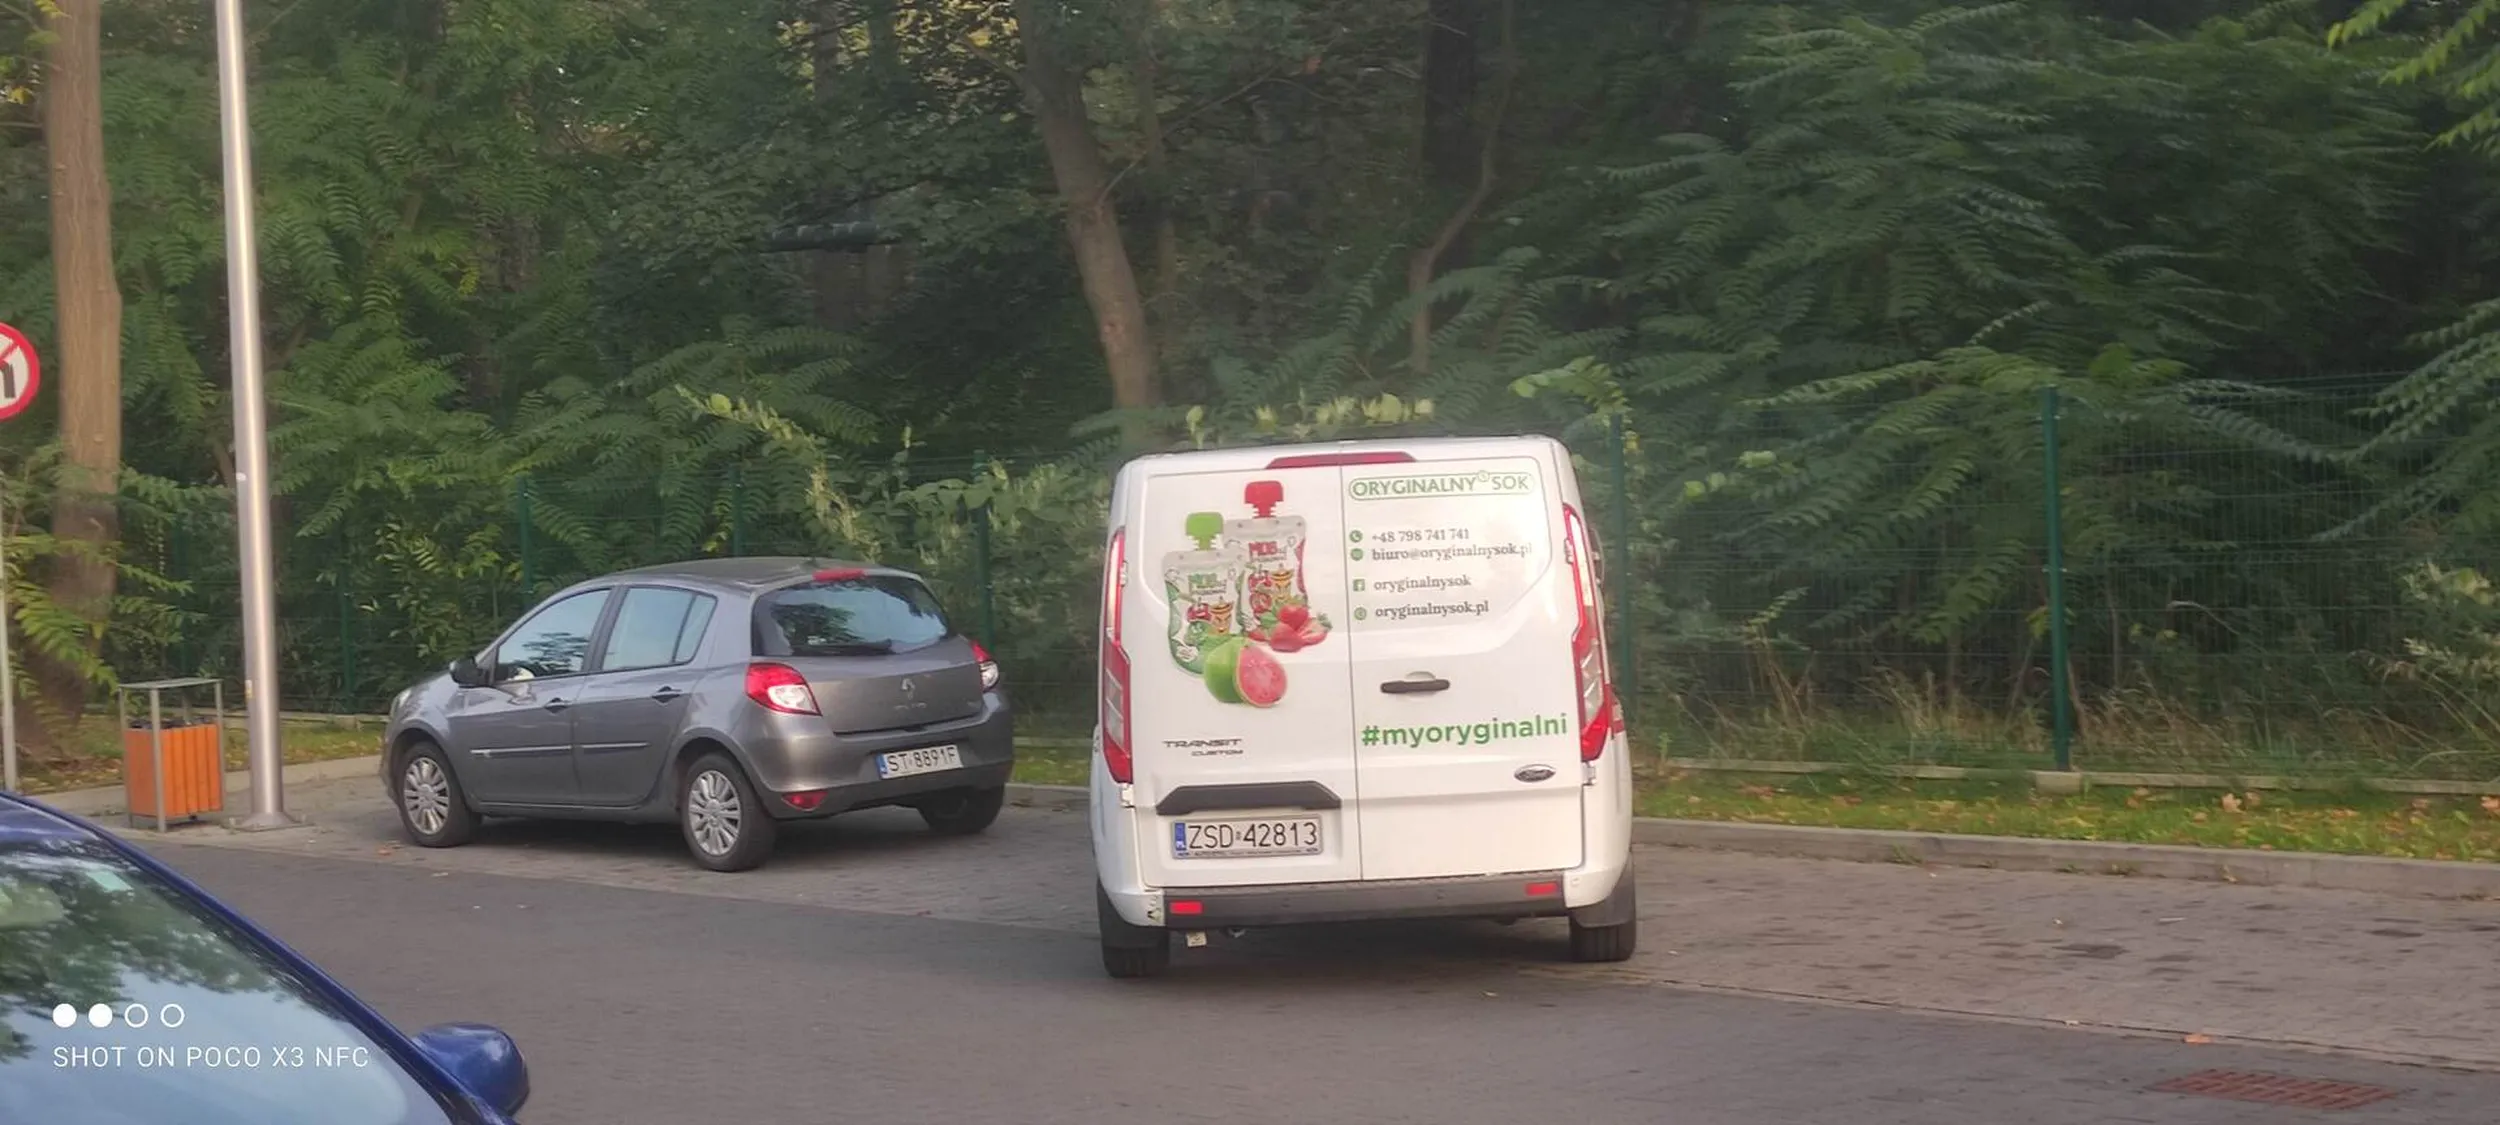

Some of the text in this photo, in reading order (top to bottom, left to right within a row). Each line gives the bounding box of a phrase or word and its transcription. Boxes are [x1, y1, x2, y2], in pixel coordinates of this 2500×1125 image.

[1352, 475, 1529, 497] ORYGINALNY SOK
[1372, 528, 1469, 544] +48 798 741 741
[1372, 542, 1532, 561] biuro@oryginalnysok.pl
[1373, 575, 1472, 593] oryginalnysok
[1375, 600, 1489, 620] oryginalnysok.pl
[1362, 713, 1568, 748] #myoryginalni
[1162, 739, 1242, 748] TRANSIT
[887, 753, 908, 772] ST
[1188, 824, 1234, 850] ZSD
[1243, 821, 1318, 848] 42813
